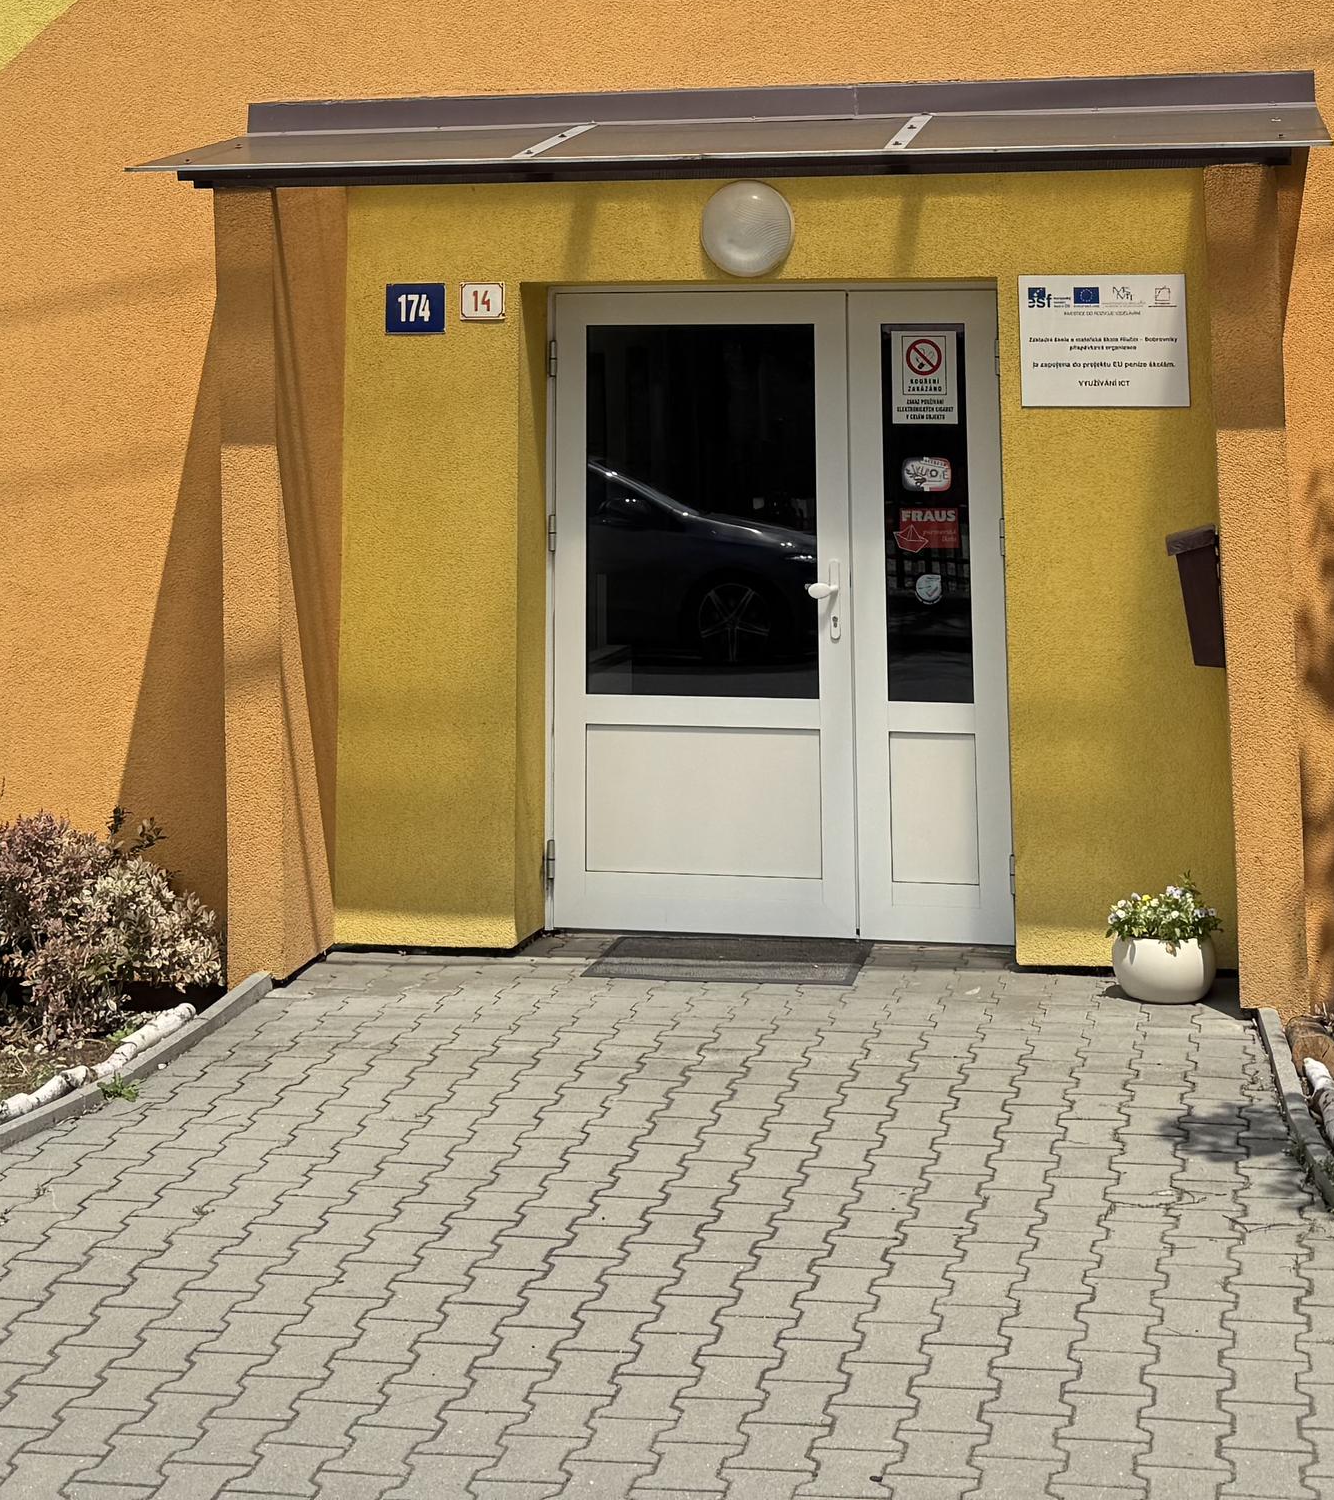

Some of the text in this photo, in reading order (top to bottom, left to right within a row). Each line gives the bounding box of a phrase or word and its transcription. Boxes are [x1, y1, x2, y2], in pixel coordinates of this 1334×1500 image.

[398, 294, 431, 323] 174
[473, 290, 491, 312] 14
[901, 510, 956, 522] FRAUS
